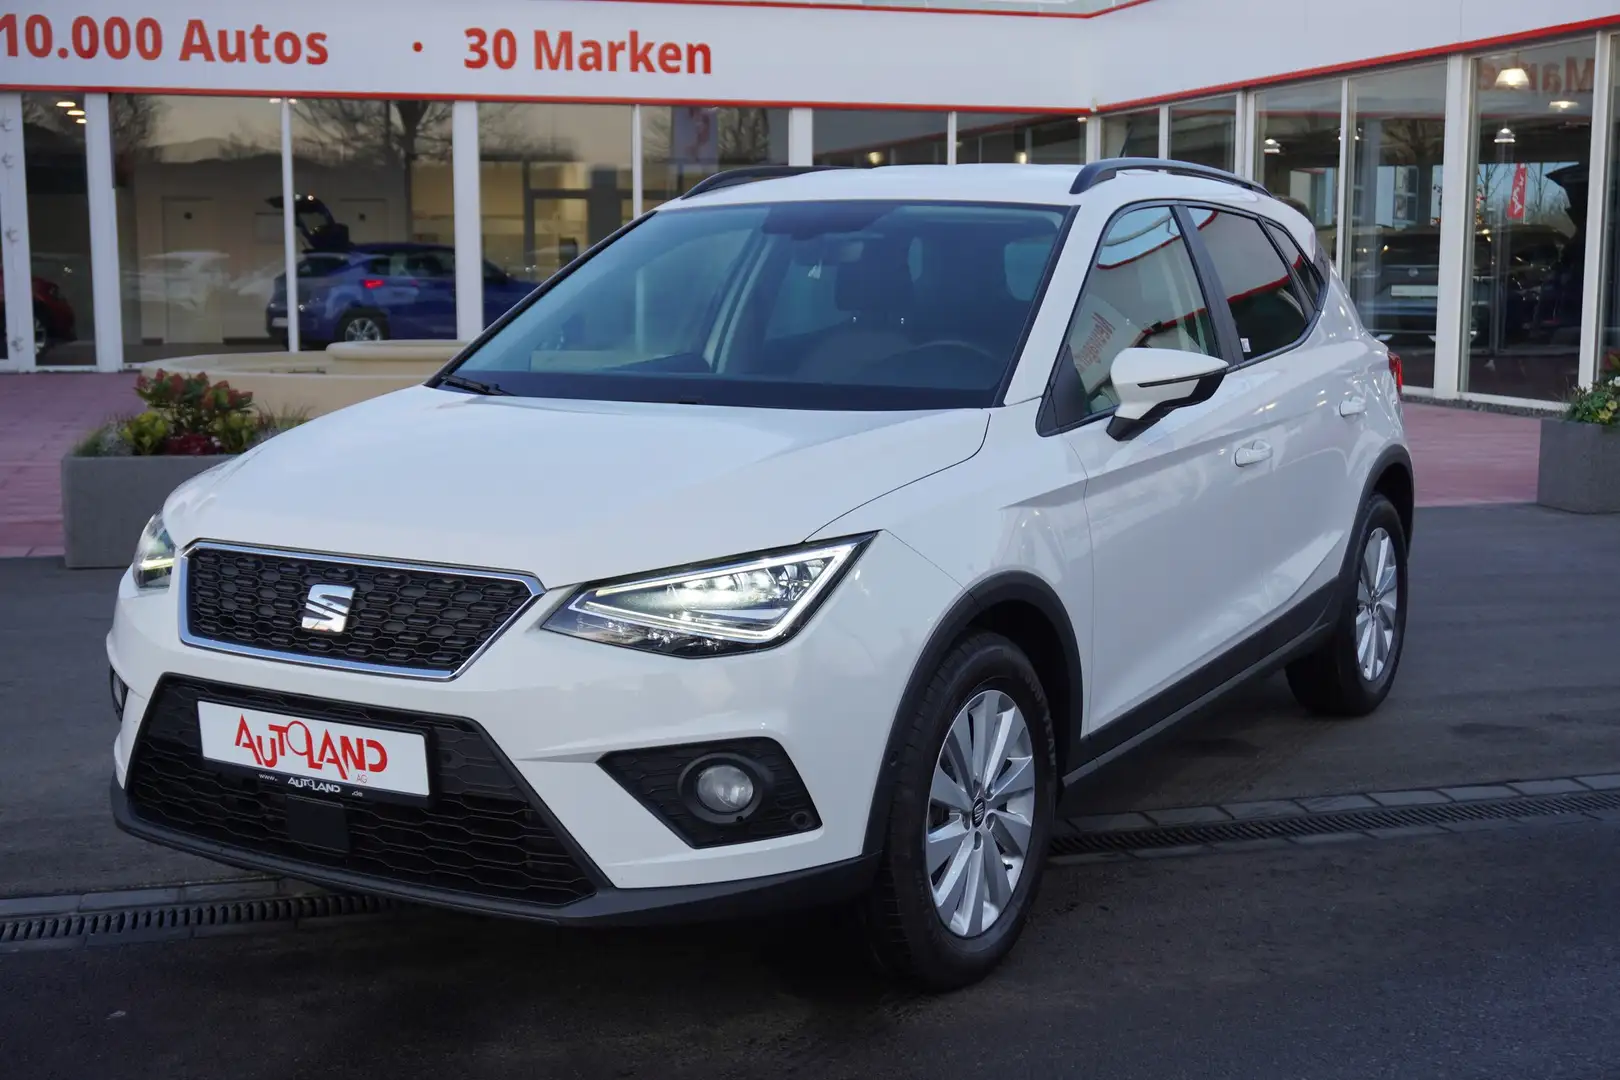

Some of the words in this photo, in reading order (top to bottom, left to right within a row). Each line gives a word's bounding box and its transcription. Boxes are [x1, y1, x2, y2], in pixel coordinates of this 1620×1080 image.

[0, 13, 163, 60] 10.000
[179, 19, 328, 65] Autos
[464, 27, 517, 70] 30
[533, 30, 712, 74] Marken
[234, 714, 388, 780] AUTOLAND
[356, 774, 368, 784] AG
